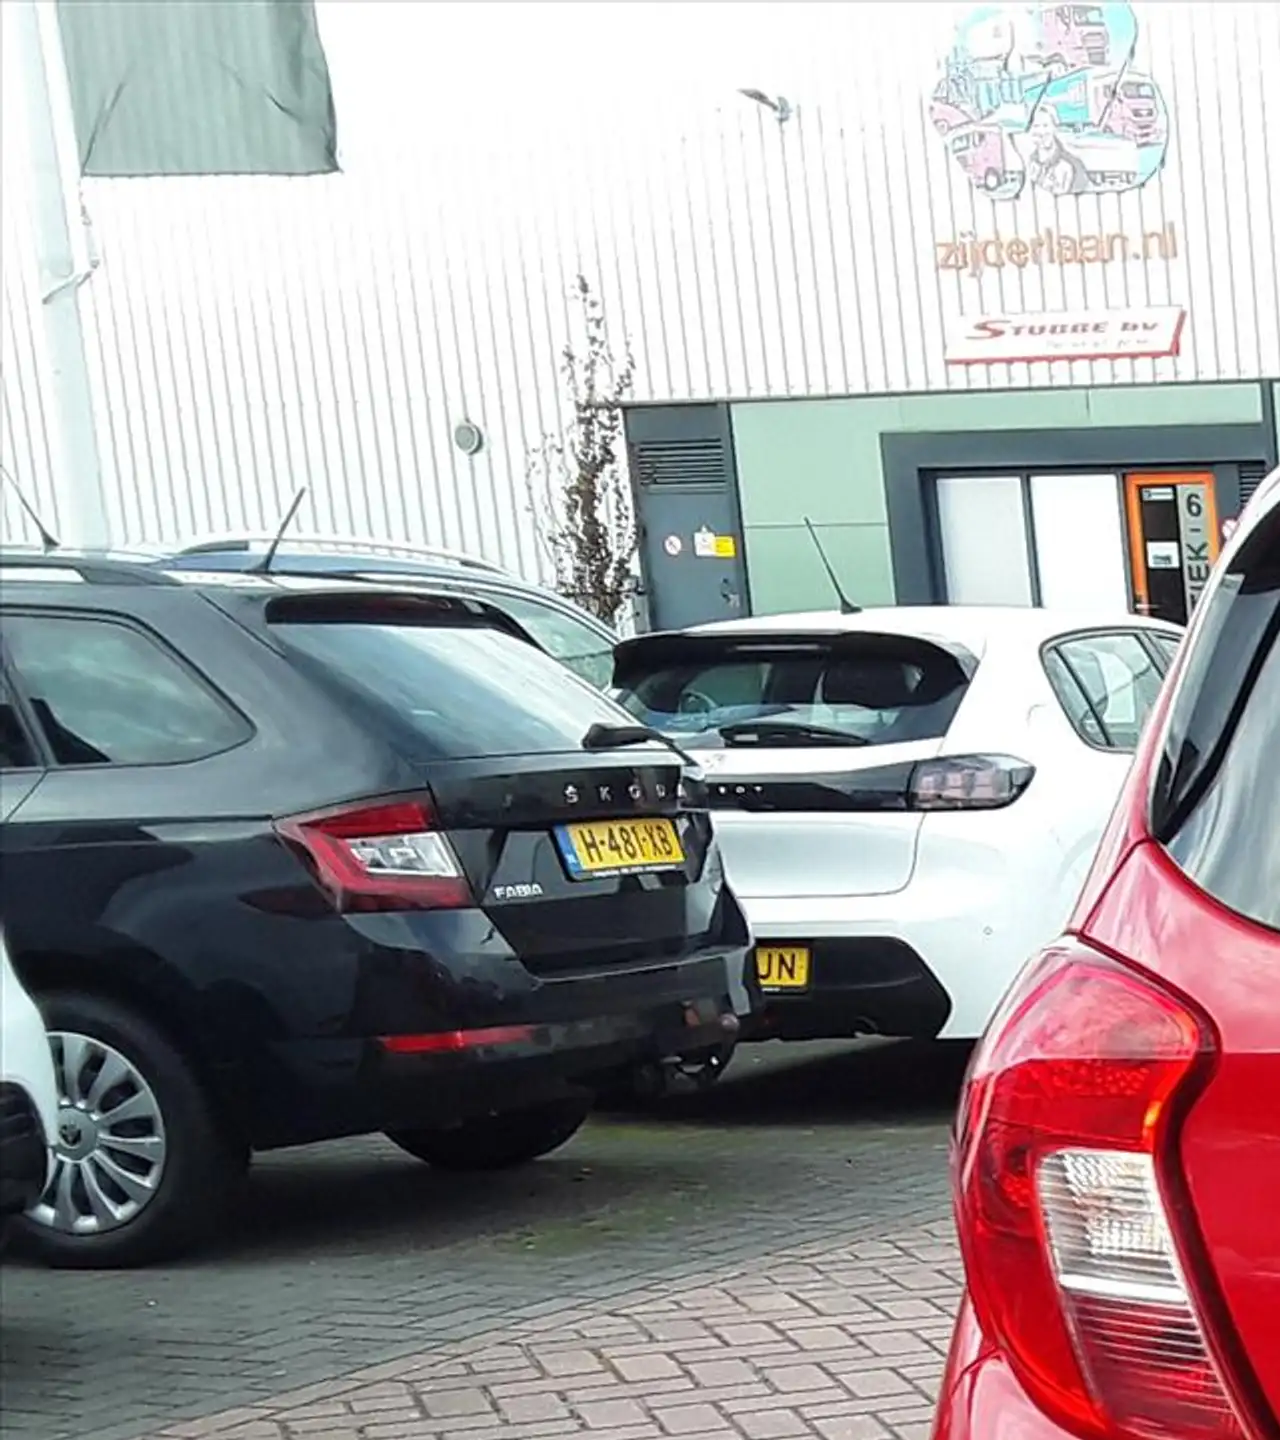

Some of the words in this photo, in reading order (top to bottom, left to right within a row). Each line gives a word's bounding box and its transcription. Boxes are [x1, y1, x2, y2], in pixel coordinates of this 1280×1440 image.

[936, 220, 1179, 279] zijderlaan.nl
[1186, 492, 1203, 518] 6
[493, 883, 543, 899] FABIA
